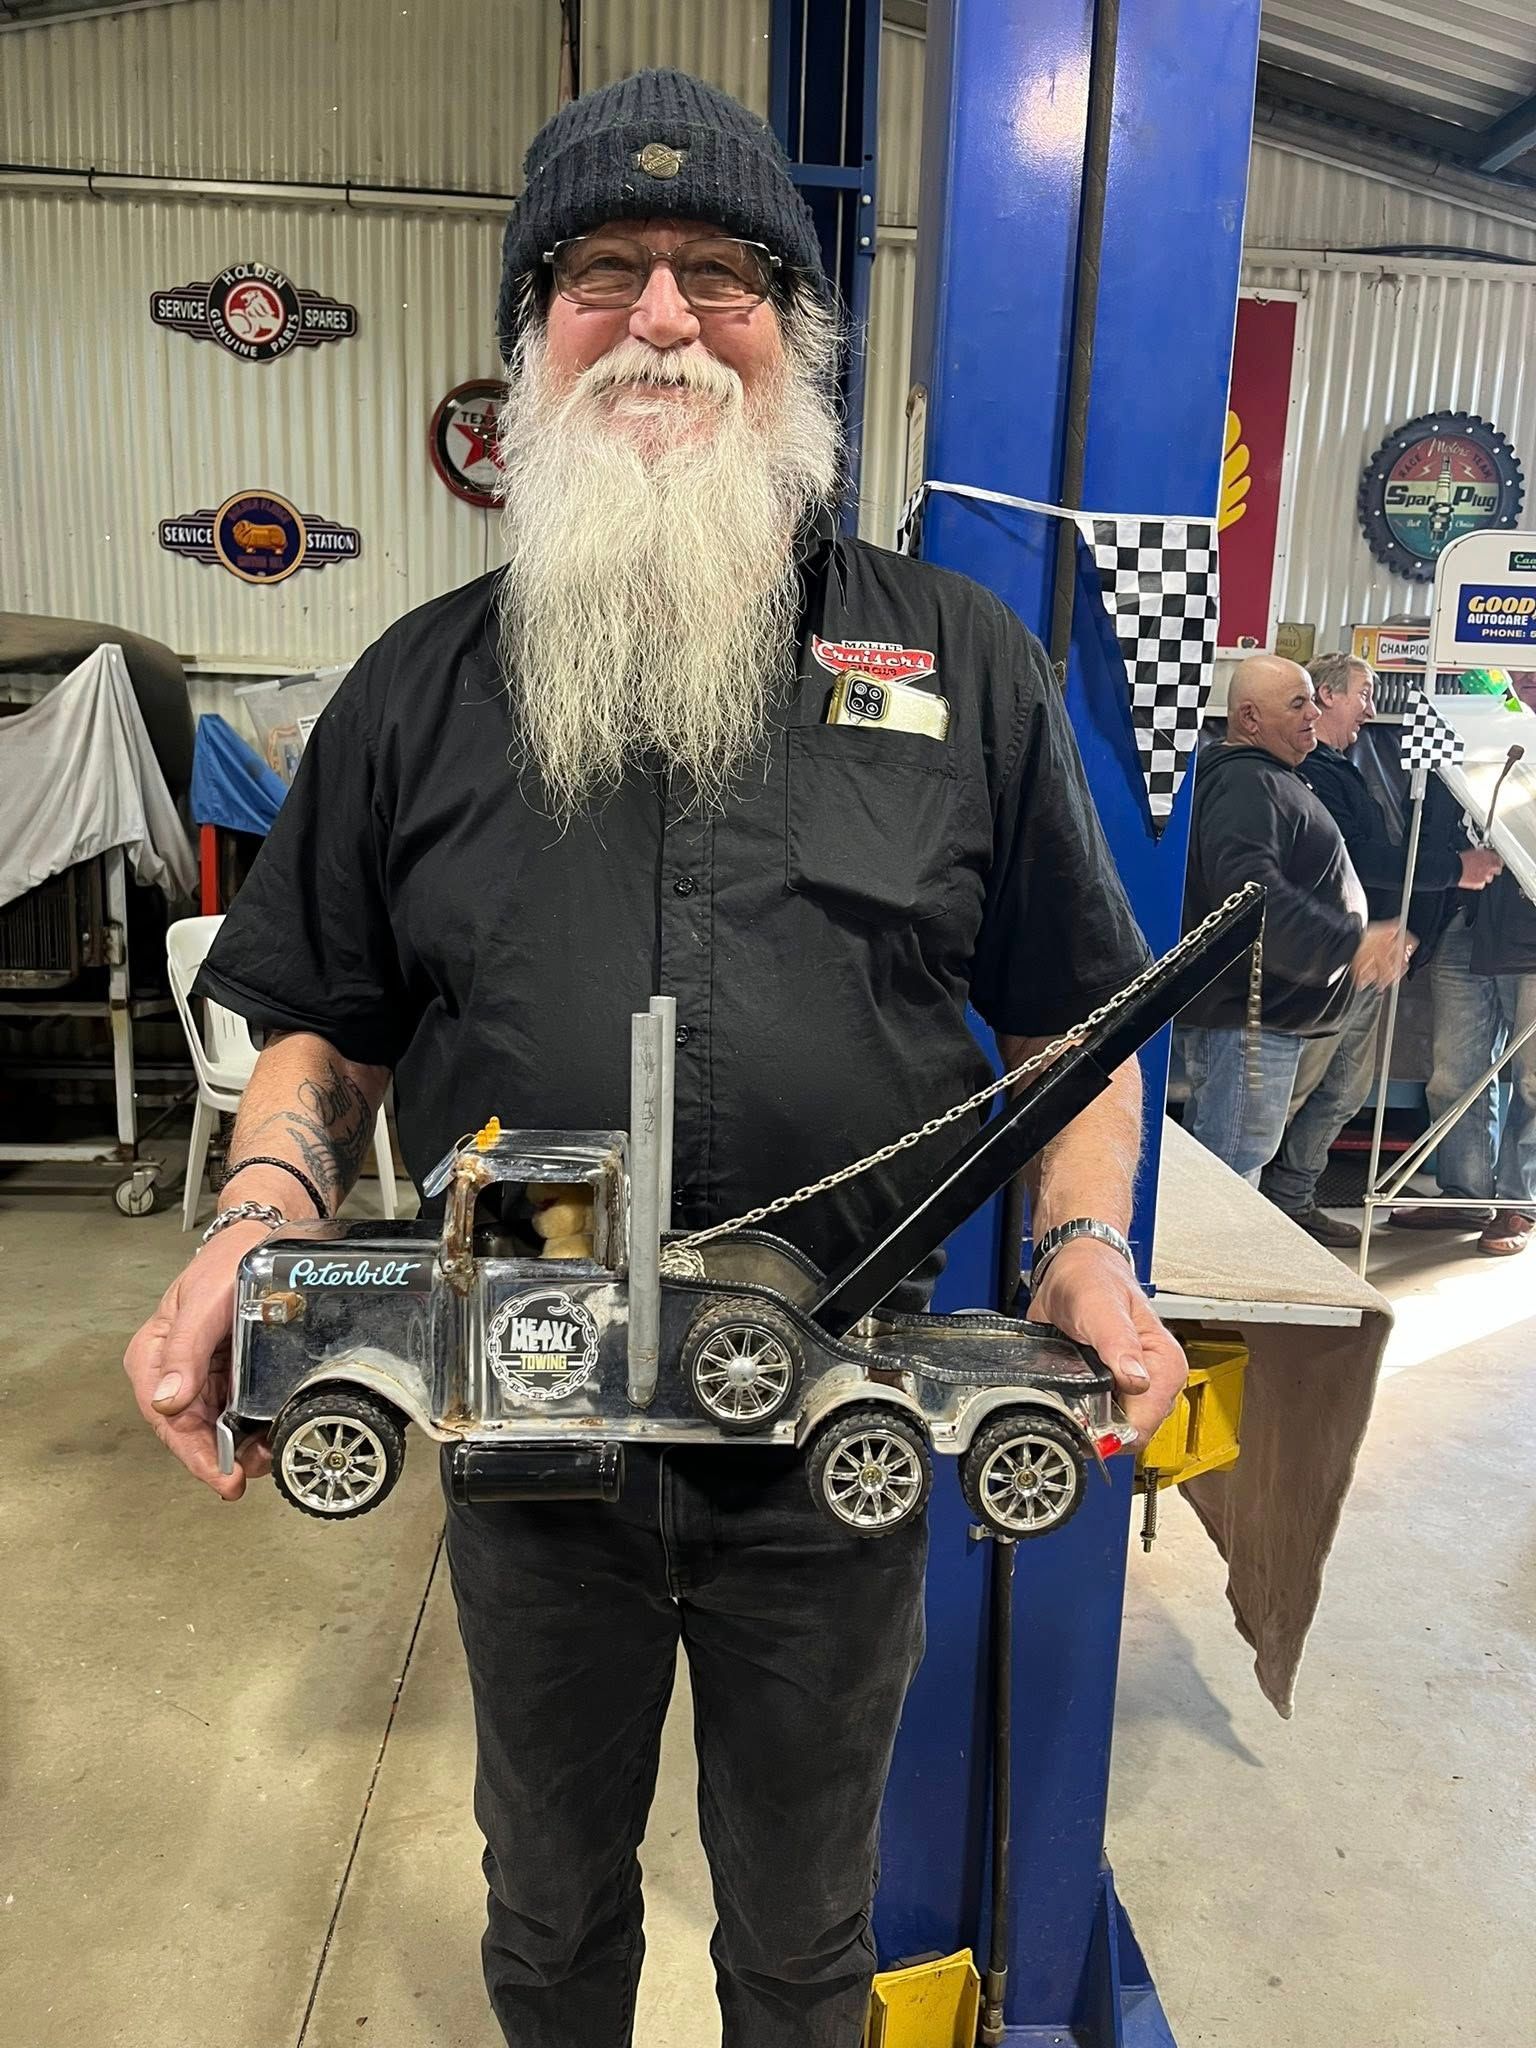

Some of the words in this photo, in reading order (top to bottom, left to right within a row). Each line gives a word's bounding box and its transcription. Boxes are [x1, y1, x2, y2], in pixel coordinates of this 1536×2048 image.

[222, 264, 287, 289] HOLDEN
[158, 299, 206, 321] SERVICE
[304, 308, 348, 330] SPARES
[210, 307, 258, 357] GENUINE
[270, 314, 299, 352] PARTS
[1472, 453, 1494, 479] TEAM
[1386, 485, 1436, 507] Spar
[1453, 486, 1498, 512] Plug
[164, 526, 213, 544] SERVICE
[307, 532, 354, 550] STATION
[1467, 613, 1528, 626] AUTOCARE
[1481, 628, 1526, 638] PHONE:
[817, 643, 931, 671] Cruisers
[1380, 643, 1428, 656] CHAMPIO
[289, 1258, 422, 1289] Peterbilt
[520, 1354, 568, 1370] TOWING
